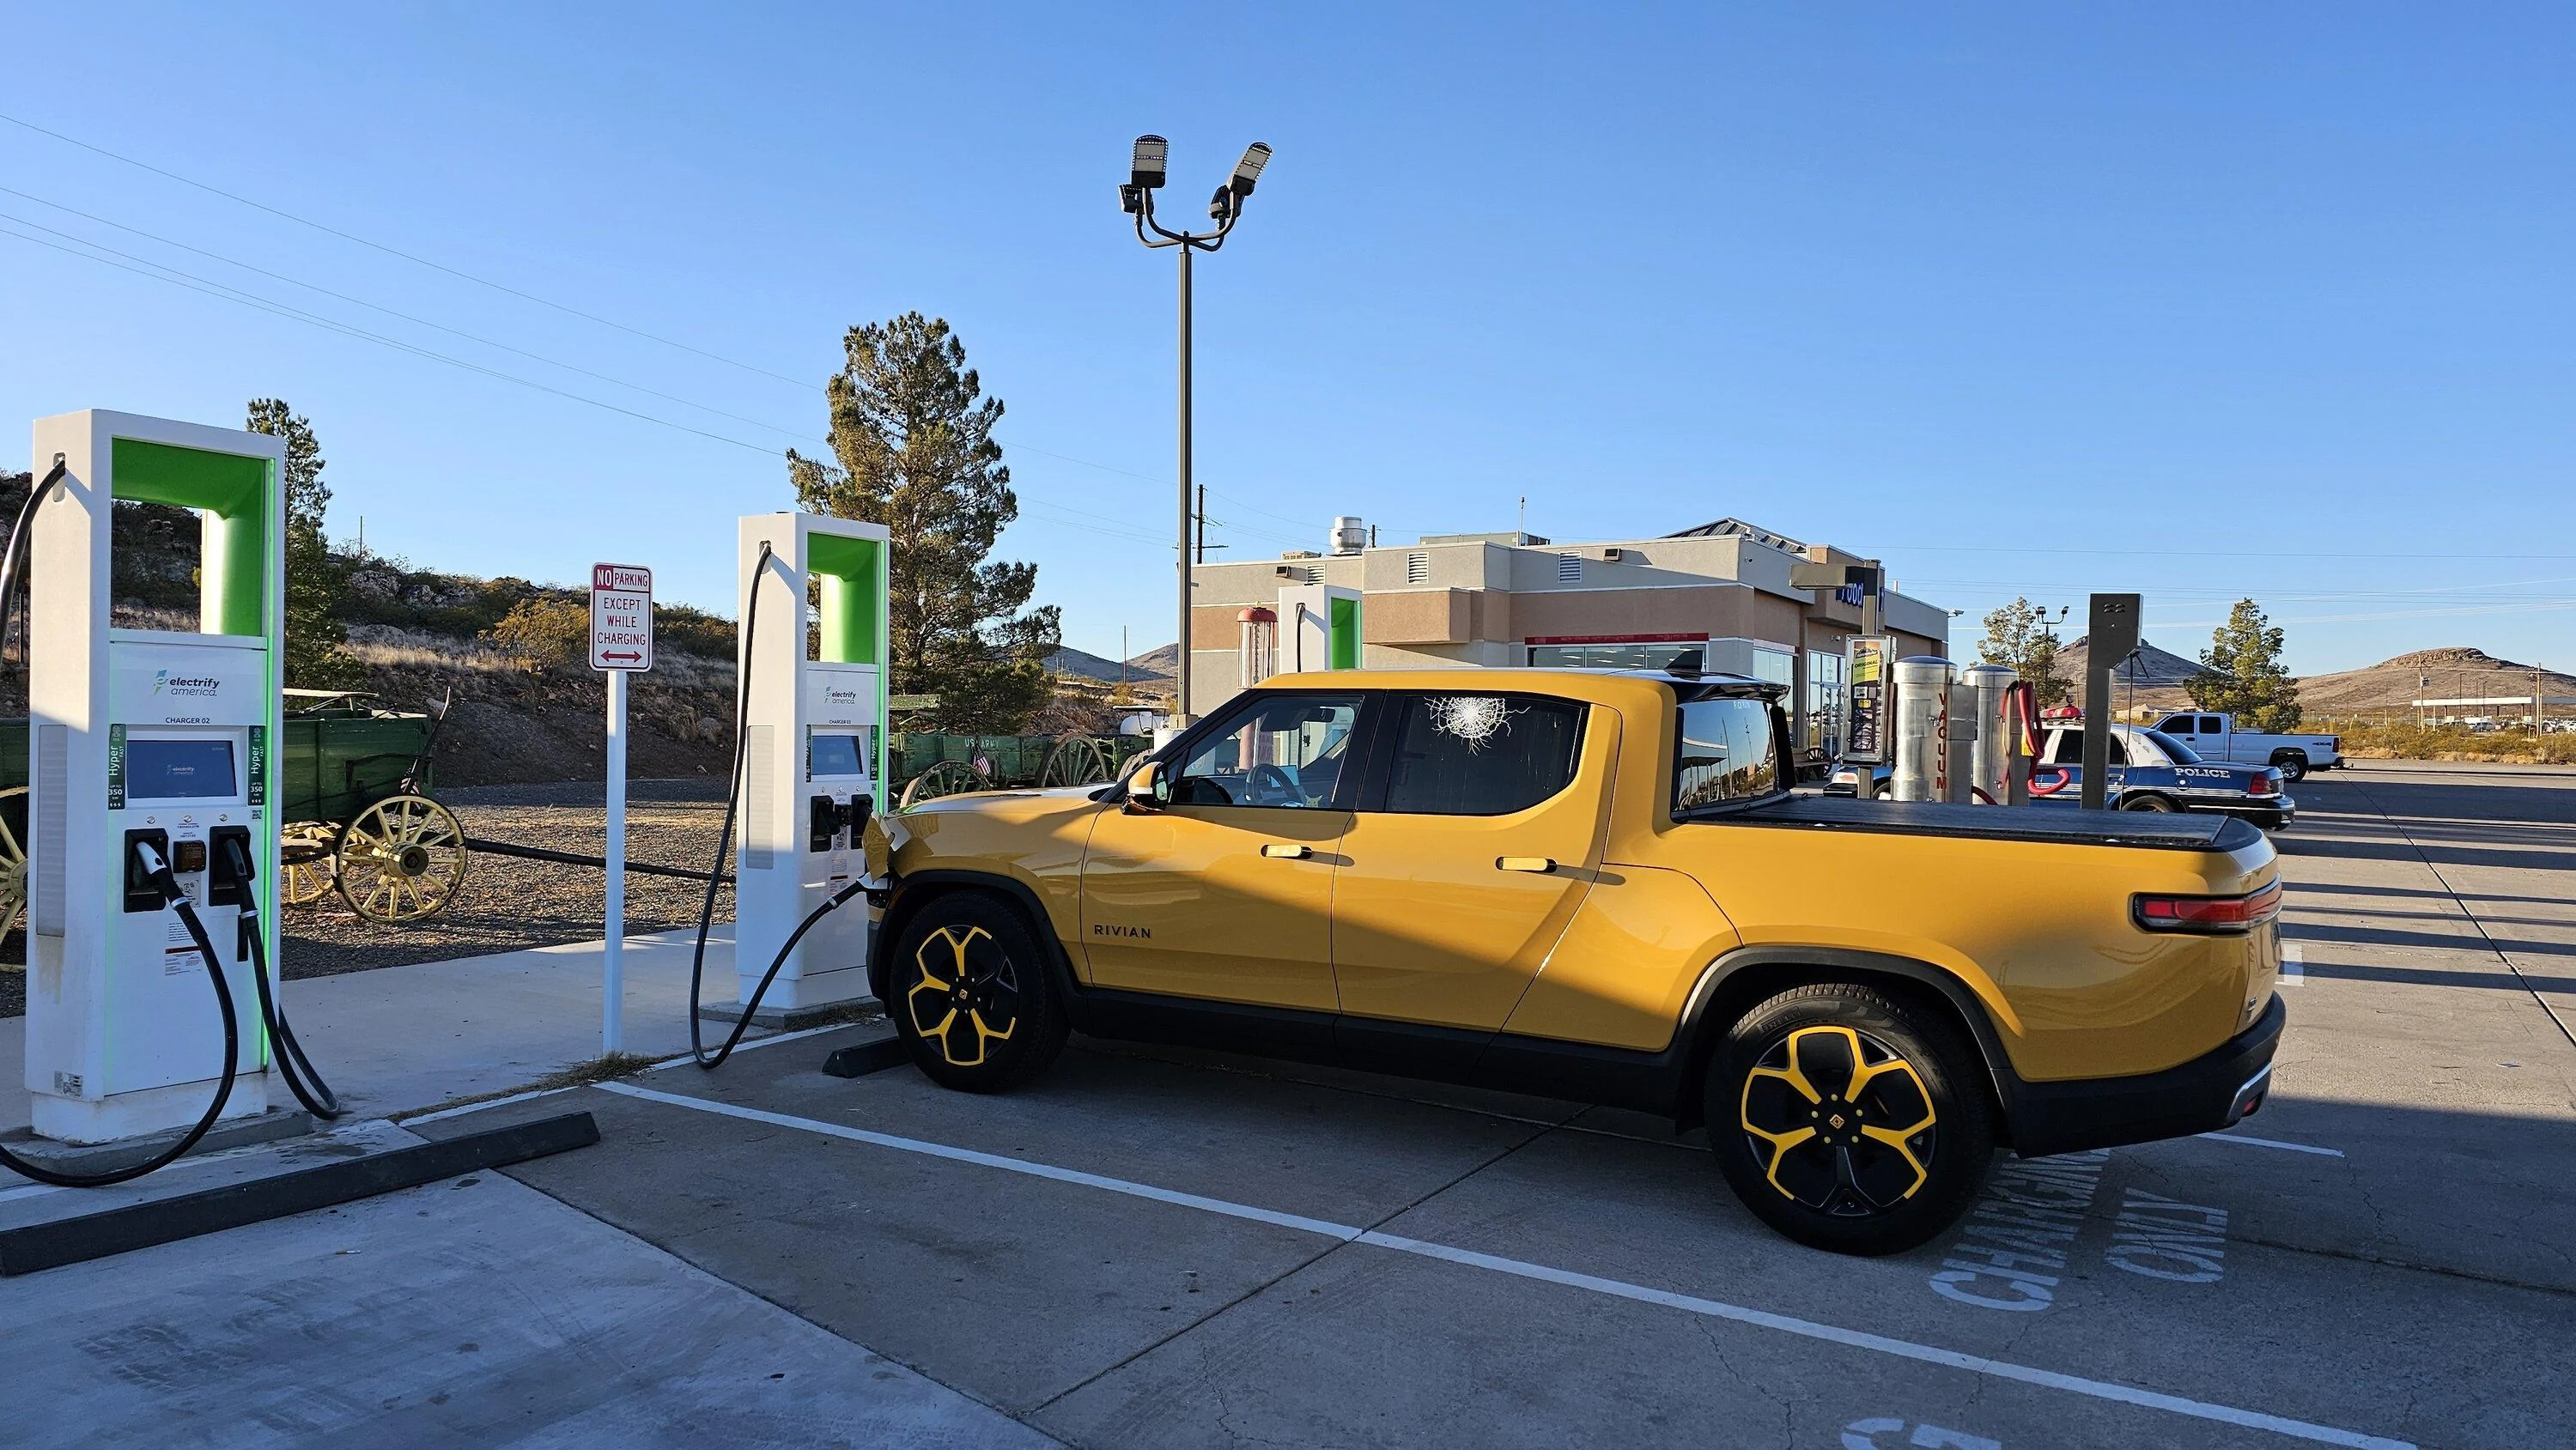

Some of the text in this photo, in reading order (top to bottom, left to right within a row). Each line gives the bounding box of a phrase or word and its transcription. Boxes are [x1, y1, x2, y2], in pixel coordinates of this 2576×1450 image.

[597, 568, 648, 587] NO PARKING
[604, 598, 641, 610] EXCEPT
[607, 615, 637, 628] WHILE
[597, 632, 646, 646] CHARGING
[169, 676, 221, 689] electrify
[831, 691, 857, 700] electrify
[1936, 693, 1947, 790] VACUUM
[108, 745, 120, 776] Hyper
[251, 745, 261, 774] Hyper
[2174, 767, 2231, 779] POLICE
[1094, 924, 1151, 938] RIVIAN
[2105, 1187, 2229, 1283] ONLY
